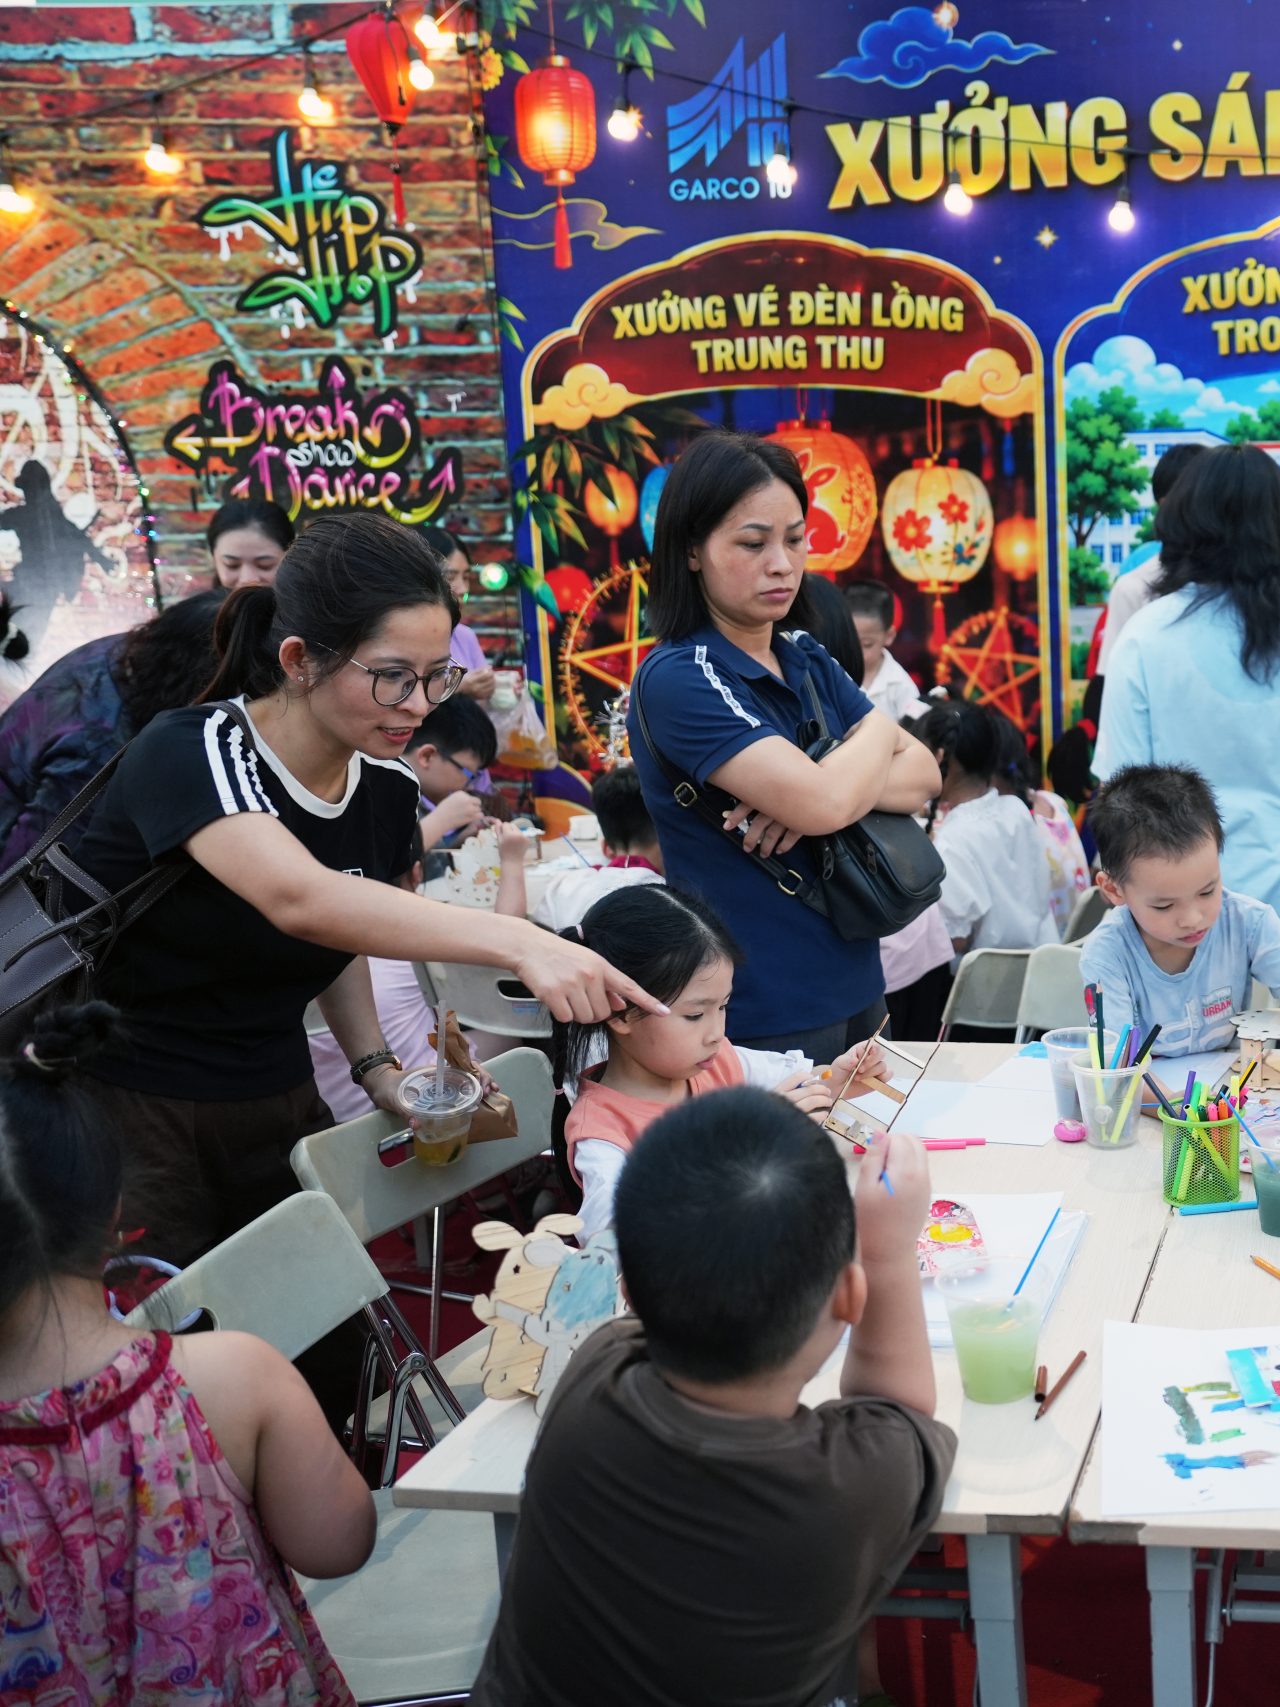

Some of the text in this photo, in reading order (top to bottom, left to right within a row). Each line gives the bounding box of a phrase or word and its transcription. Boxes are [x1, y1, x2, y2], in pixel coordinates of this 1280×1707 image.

[825, 80, 1128, 210] XƯỞNG
[669, 176, 760, 201] GARCO
[611, 289, 728, 340] XƯỞNG
[788, 283, 861, 327] ĐÈN
[872, 281, 965, 333] LỒNG
[691, 335, 885, 373] TRUNG THU
[1202, 999, 1232, 1017] URBAN
